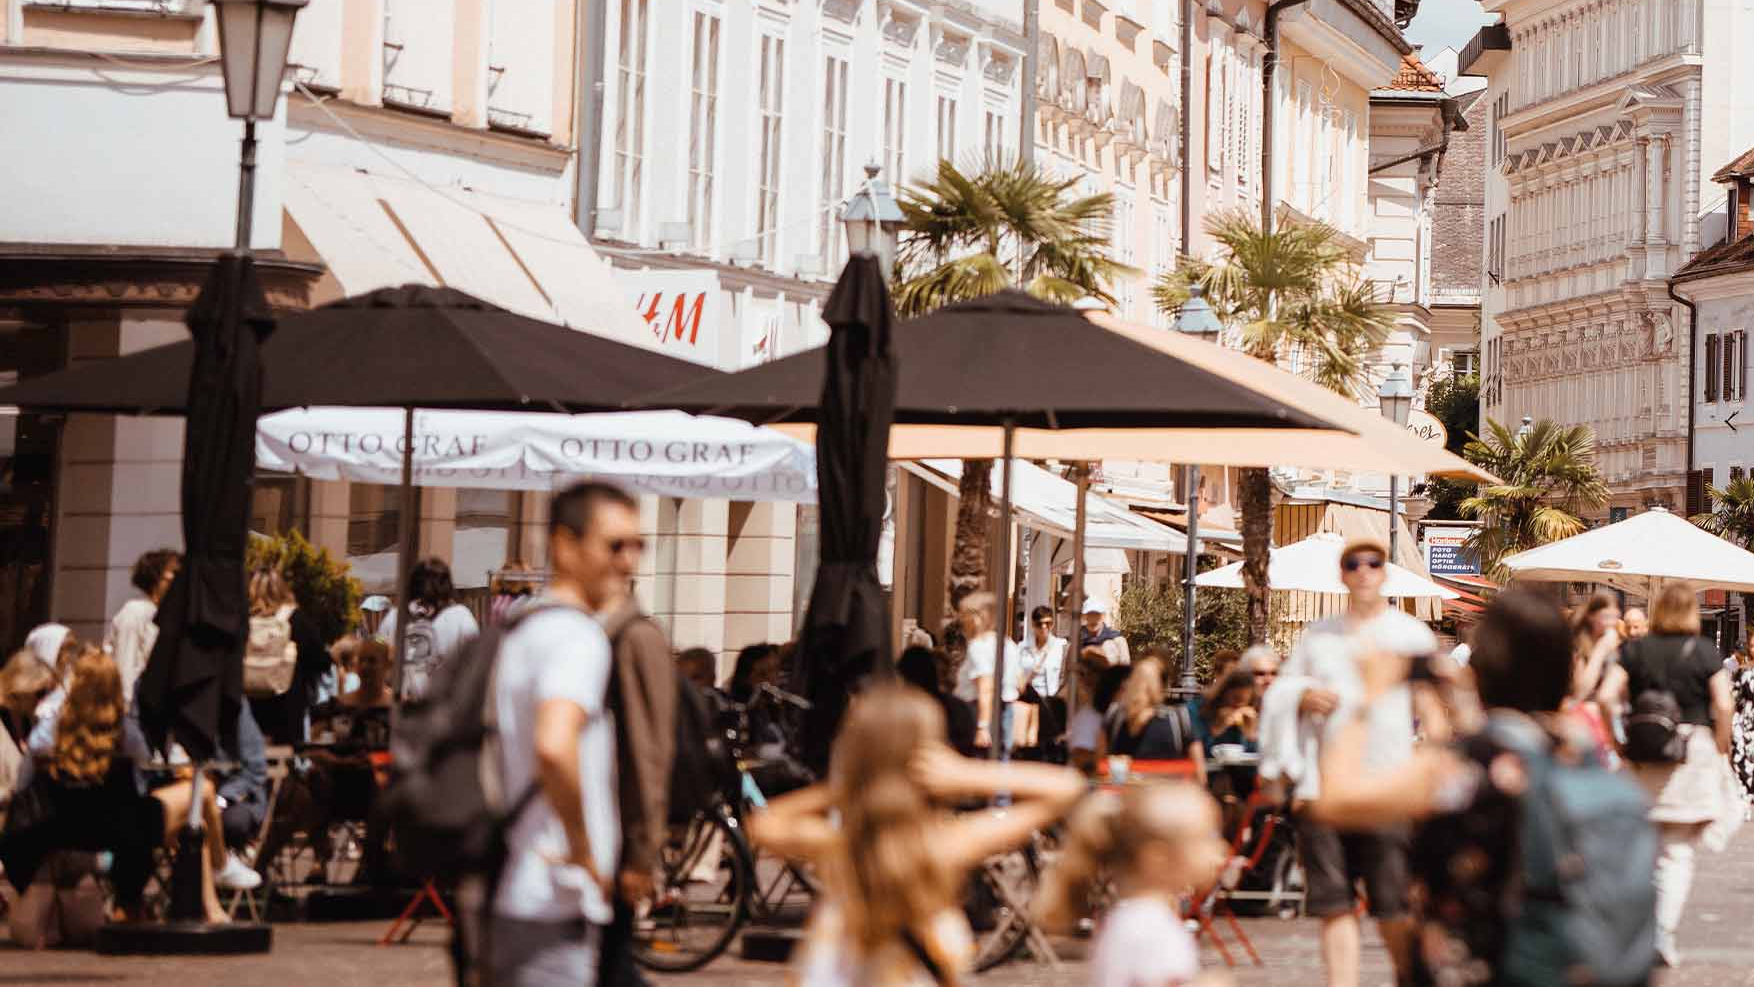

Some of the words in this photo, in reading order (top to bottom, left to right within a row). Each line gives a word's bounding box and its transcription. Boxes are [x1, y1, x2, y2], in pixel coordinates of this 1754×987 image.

[288, 431, 383, 455] OTTO
[396, 434, 488, 456] GRAF
[560, 437, 653, 461] OTTO
[664, 440, 757, 465] GRAF
